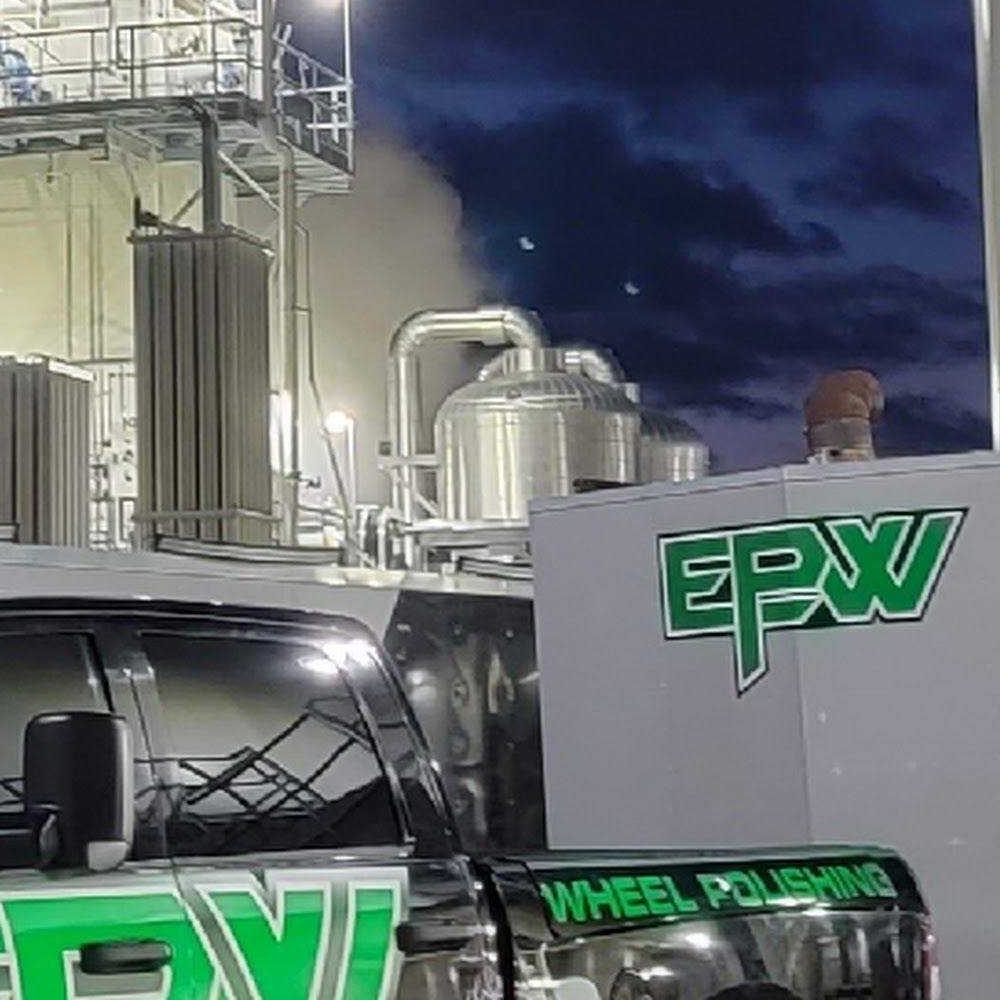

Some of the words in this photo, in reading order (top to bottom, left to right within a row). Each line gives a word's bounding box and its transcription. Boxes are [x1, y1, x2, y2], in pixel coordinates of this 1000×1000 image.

[657, 507, 969, 698] EPW
[541, 875, 698, 922] WHEEL
[697, 863, 896, 908] POLISHING
